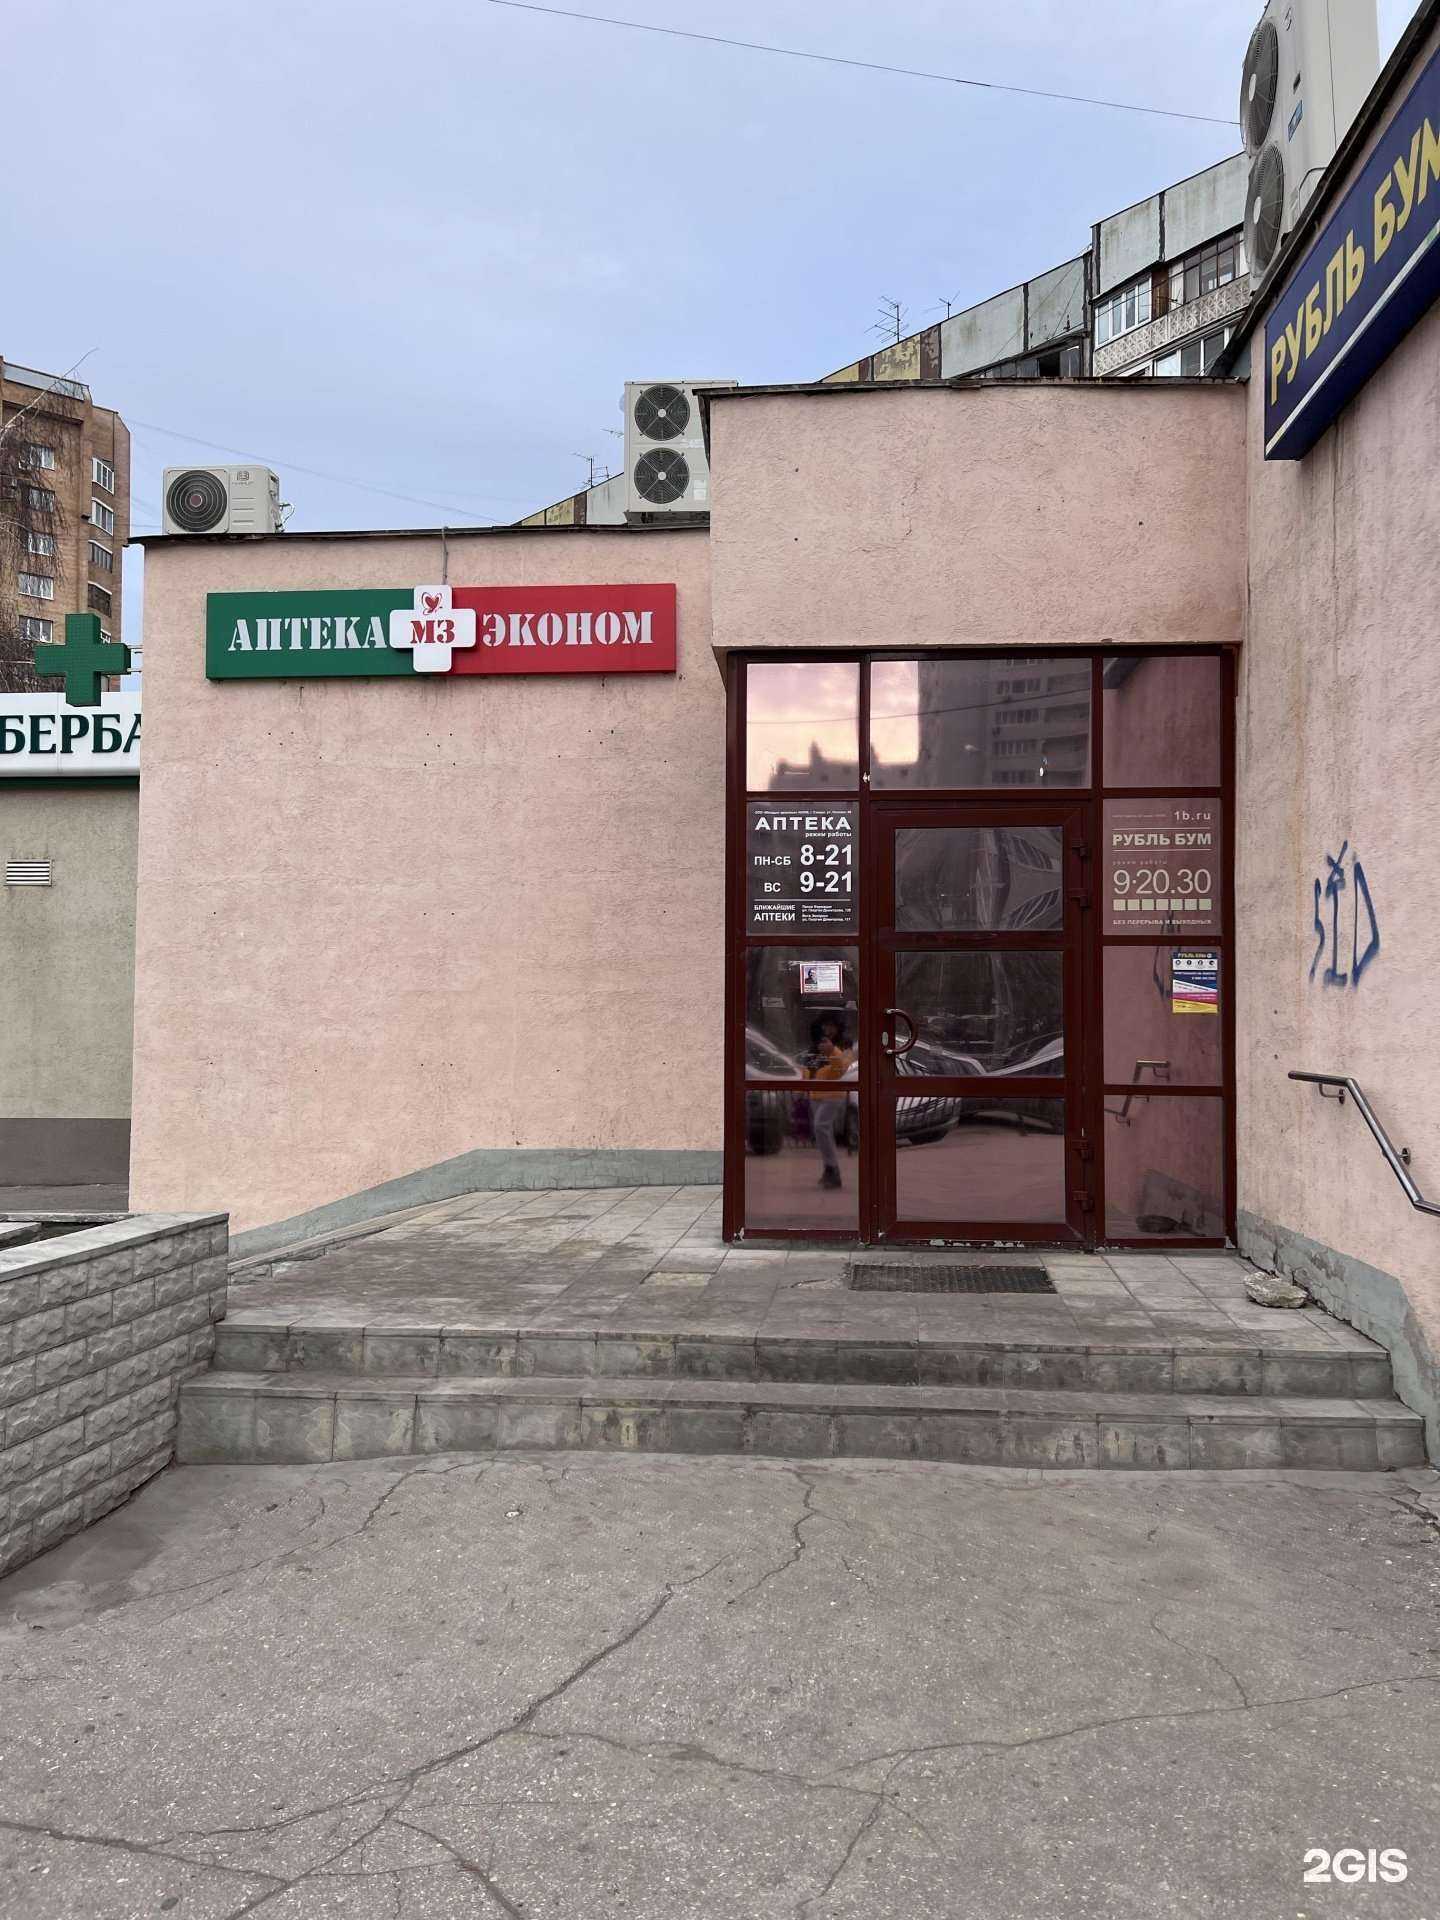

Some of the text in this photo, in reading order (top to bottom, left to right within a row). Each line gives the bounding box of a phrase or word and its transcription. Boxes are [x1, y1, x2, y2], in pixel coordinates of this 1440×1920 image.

[1271, 229, 1365, 406] РУБЛЬ
[228, 616, 388, 652] АПТЕКА
[481, 611, 655, 648] ЭКОНОМ
[754, 816, 852, 831] АПТЕКА
[1174, 810, 1212, 821] 1b.ru
[1112, 832, 1212, 846] РУБЛЬ БУМ
[754, 844, 852, 866] ПН-СБ 8-21
[764, 871, 852, 893] ВС 9-21
[753, 912, 796, 922] АПТЕКИ
